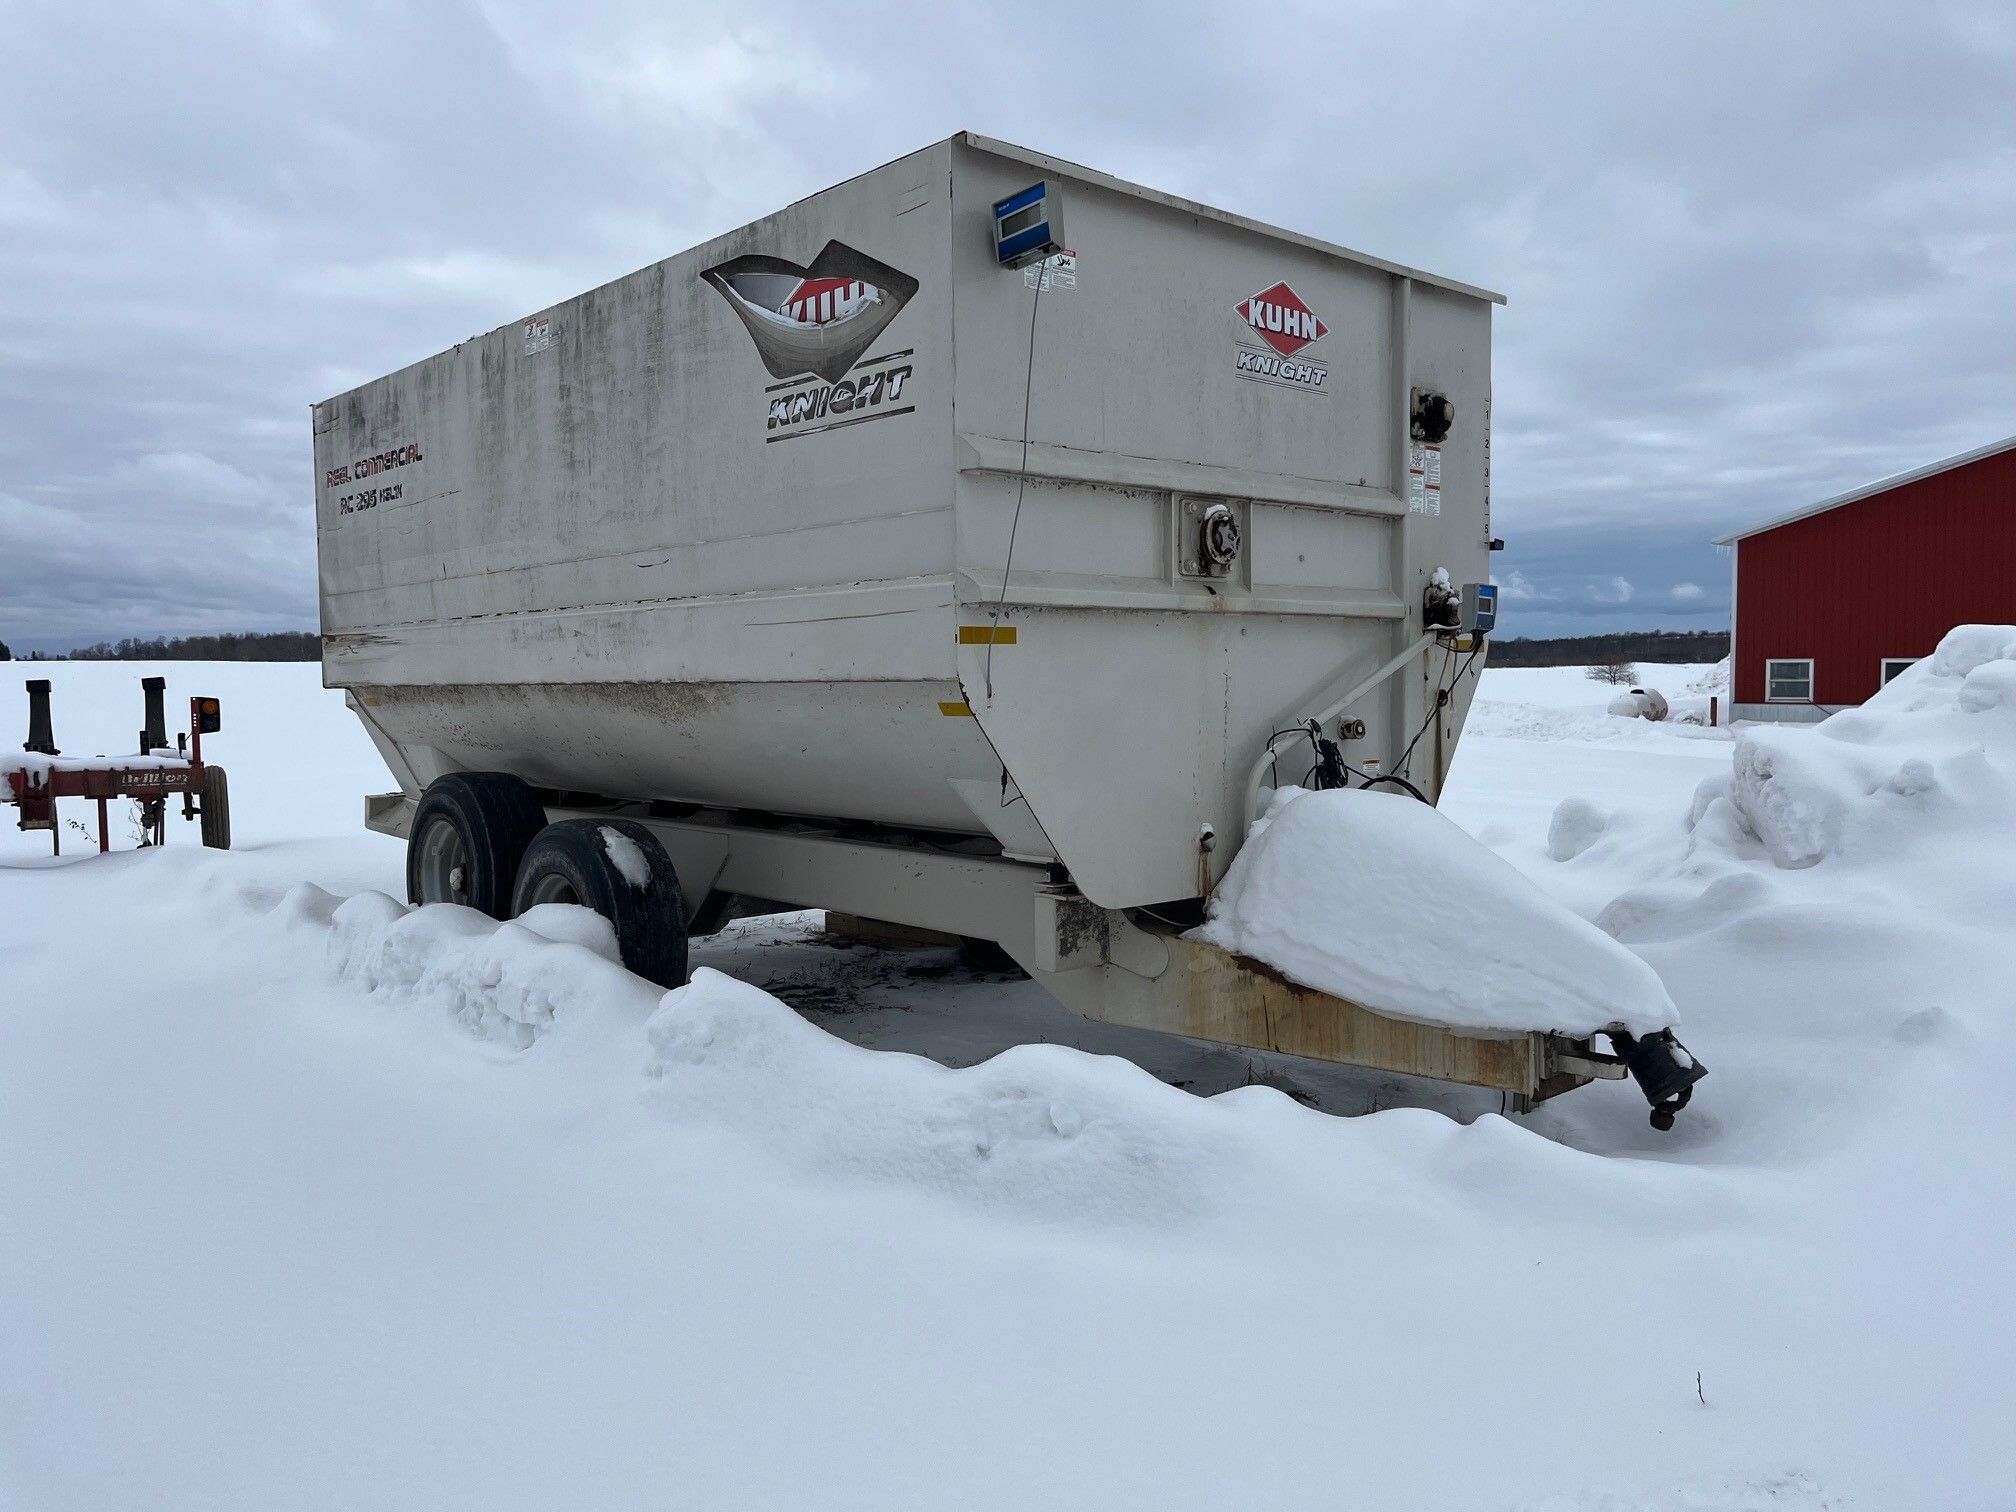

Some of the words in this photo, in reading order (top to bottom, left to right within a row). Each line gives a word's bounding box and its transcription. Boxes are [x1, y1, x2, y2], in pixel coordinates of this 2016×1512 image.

[1248, 298, 1317, 342] KUHN
[1236, 351, 1328, 386] KNIGHT
[766, 364, 913, 430] KNIGHT
[1484, 439, 1490, 449] 2
[354, 443, 423, 480] COMMERCIAL
[1484, 467, 1490, 478] 3
[340, 495, 354, 515] RC
[1484, 496, 1490, 506] 4
[1484, 524, 1489, 535] 5
